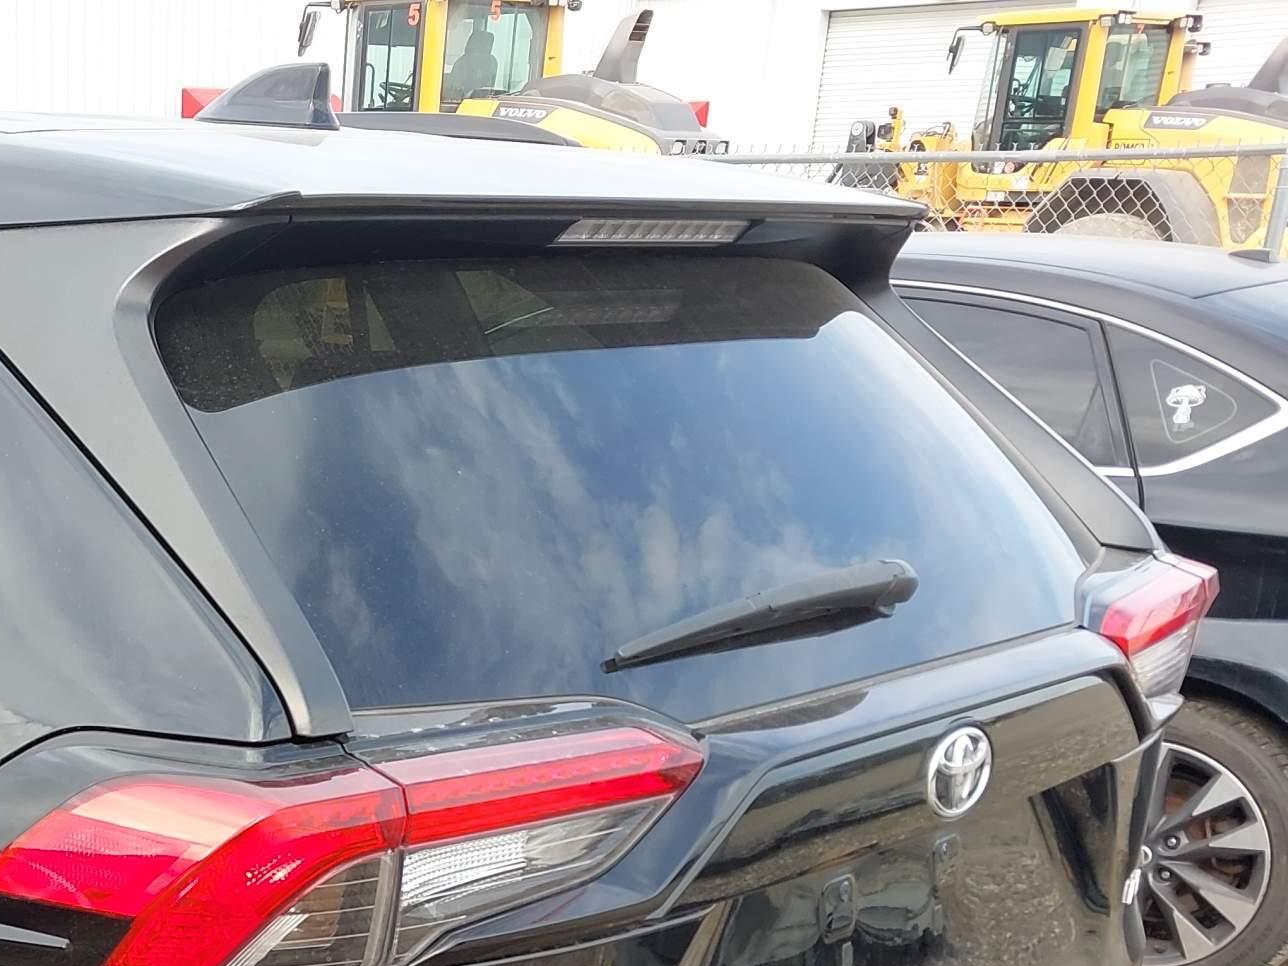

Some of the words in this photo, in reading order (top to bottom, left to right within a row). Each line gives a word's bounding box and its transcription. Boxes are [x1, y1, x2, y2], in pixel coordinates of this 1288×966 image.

[408, 3, 421, 26] 5
[499, 106, 547, 119] VOLVO
[1152, 116, 1208, 126] VOLVO
